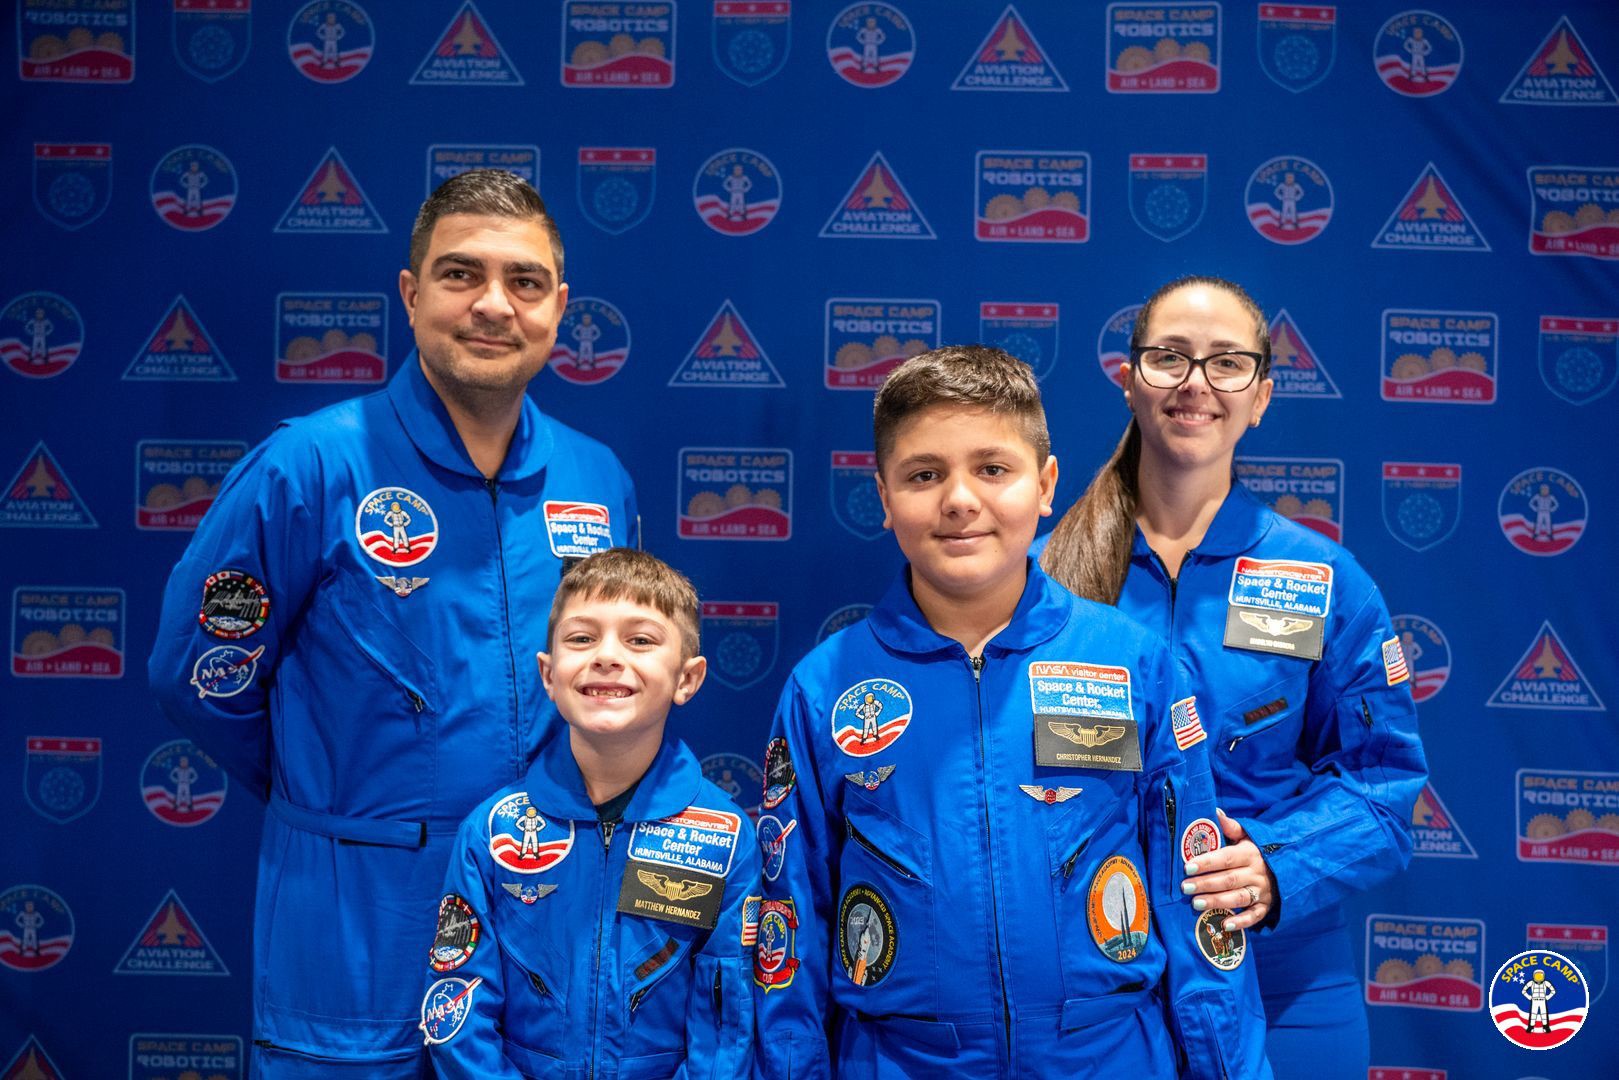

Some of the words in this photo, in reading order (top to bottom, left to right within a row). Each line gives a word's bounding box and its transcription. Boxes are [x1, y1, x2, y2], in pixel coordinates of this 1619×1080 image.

[572, 4, 620, 16] SPACE
[624, 5, 669, 17] CAMP
[1116, 9, 1164, 21] SPACE
[1169, 9, 1214, 21] CAMP
[571, 18, 669, 32] ROBOTICS
[1115, 23, 1214, 37] ROBOTICS
[433, 58, 501, 69] AVIATION
[975, 64, 1045, 75] AVIATION
[422, 69, 509, 80] CHALLENGE
[964, 75, 1054, 86] CHALLENGE
[1120, 78, 1138, 87] AIR
[1149, 78, 1177, 88] LAND
[1186, 78, 1206, 88] SEA
[1524, 77, 1597, 89] AVIATION
[1511, 89, 1606, 101] CHALLENGE
[436, 151, 484, 163] SPACE
[488, 152, 533, 164] CAMP
[985, 157, 1033, 169] SPACE
[1038, 158, 1083, 170] CAMP
[984, 172, 1083, 186] ROBOTICS
[297, 206, 365, 217] AVIATION
[843, 211, 912, 222] AVIATION
[286, 217, 373, 228] CHALLENGE
[832, 222, 921, 234] CHALLENGE
[1395, 222, 1466, 234] AVIATION
[989, 226, 1007, 236] AIR
[1018, 227, 1046, 237] LAND
[1056, 227, 1076, 237] SEA
[1384, 233, 1475, 245] CHALLENGE
[835, 305, 883, 317] SPACE
[888, 306, 933, 318] CAMP
[834, 319, 933, 334] ROBOTICS
[1391, 316, 1440, 329] SPACE
[1445, 318, 1490, 331] CAMP
[1390, 331, 1490, 346] ROBOTICS
[145, 354, 213, 365] AVIATION
[692, 360, 762, 371] AVIATION
[134, 365, 222, 376] CHALLENGE
[681, 371, 770, 382] CHALLENGE
[1395, 386, 1412, 396] AIR
[1424, 387, 1452, 398] LAND
[1462, 388, 1482, 398] SEA
[687, 454, 736, 466] SPACE
[741, 455, 786, 467] CAMP
[686, 469, 786, 483] ROBOTICS
[1291, 465, 1336, 478] CAMP
[6, 500, 75, 511] AVIATION
[364, 492, 393, 516] SPACE
[396, 492, 427, 514] CAMP
[550, 522, 577, 535] Space
[578, 523, 586, 534] &
[691, 524, 709, 534] AIR
[721, 524, 748, 535] LAND
[758, 525, 777, 535] SEA
[572, 534, 598, 546] Center
[1238, 576, 1272, 587] Space
[1274, 578, 1283, 589] &
[1286, 579, 1326, 595] Rocket
[1261, 587, 1298, 602] Center
[1236, 596, 1282, 608] HUNTSVILLE,
[1284, 602, 1321, 614] ALABAMA
[1036, 666, 1070, 676] NASA
[1071, 668, 1097, 678] visitor
[1099, 672, 1125, 682] center
[1037, 680, 1073, 694] Space
[1076, 683, 1084, 694] &
[1087, 683, 1126, 698] Rocket
[1512, 681, 1582, 693] AVIATION
[839, 686, 868, 712] SPACE
[872, 683, 903, 699] CAMP
[1502, 692, 1590, 705] CHALLENGE
[1056, 753, 1092, 762] CHRISTOPHER
[1092, 756, 1122, 764] HERNANDEZ
[1525, 776, 1577, 789] SPACE
[1582, 779, 1619, 792] CAM
[1525, 791, 1619, 808] ROBOTIC
[497, 796, 530, 818] SPACE
[638, 822, 675, 838] Space
[678, 828, 687, 840] &
[690, 830, 732, 848] Rocket
[1190, 824, 1198, 835] AND
[662, 838, 702, 856] Center
[1531, 846, 1549, 856] AIR
[1562, 848, 1591, 858] LAND
[634, 848, 684, 864] HUNTSVILLE,
[684, 856, 723, 872] ALABAMA
[634, 898, 665, 912] MATTHEW
[666, 906, 701, 920] HERNANDEZ
[1202, 908, 1224, 924] APOLLO
[884, 912, 894, 936] SPACE
[1376, 922, 1426, 935] SPACE
[1431, 925, 1478, 938] CAMP
[1375, 937, 1478, 953] ROBOTICS
[137, 948, 206, 959] AVIATION
[883, 936, 895, 970] ACADEMY
[1118, 948, 1136, 960] 2024
[126, 959, 214, 970] CHALLENGE
[762, 973, 774, 984] CUP
[1379, 990, 1397, 1000] AIR
[1410, 992, 1438, 1003] LAND
[1448, 994, 1468, 1005] SEA
[427, 998, 464, 1022] NASA
